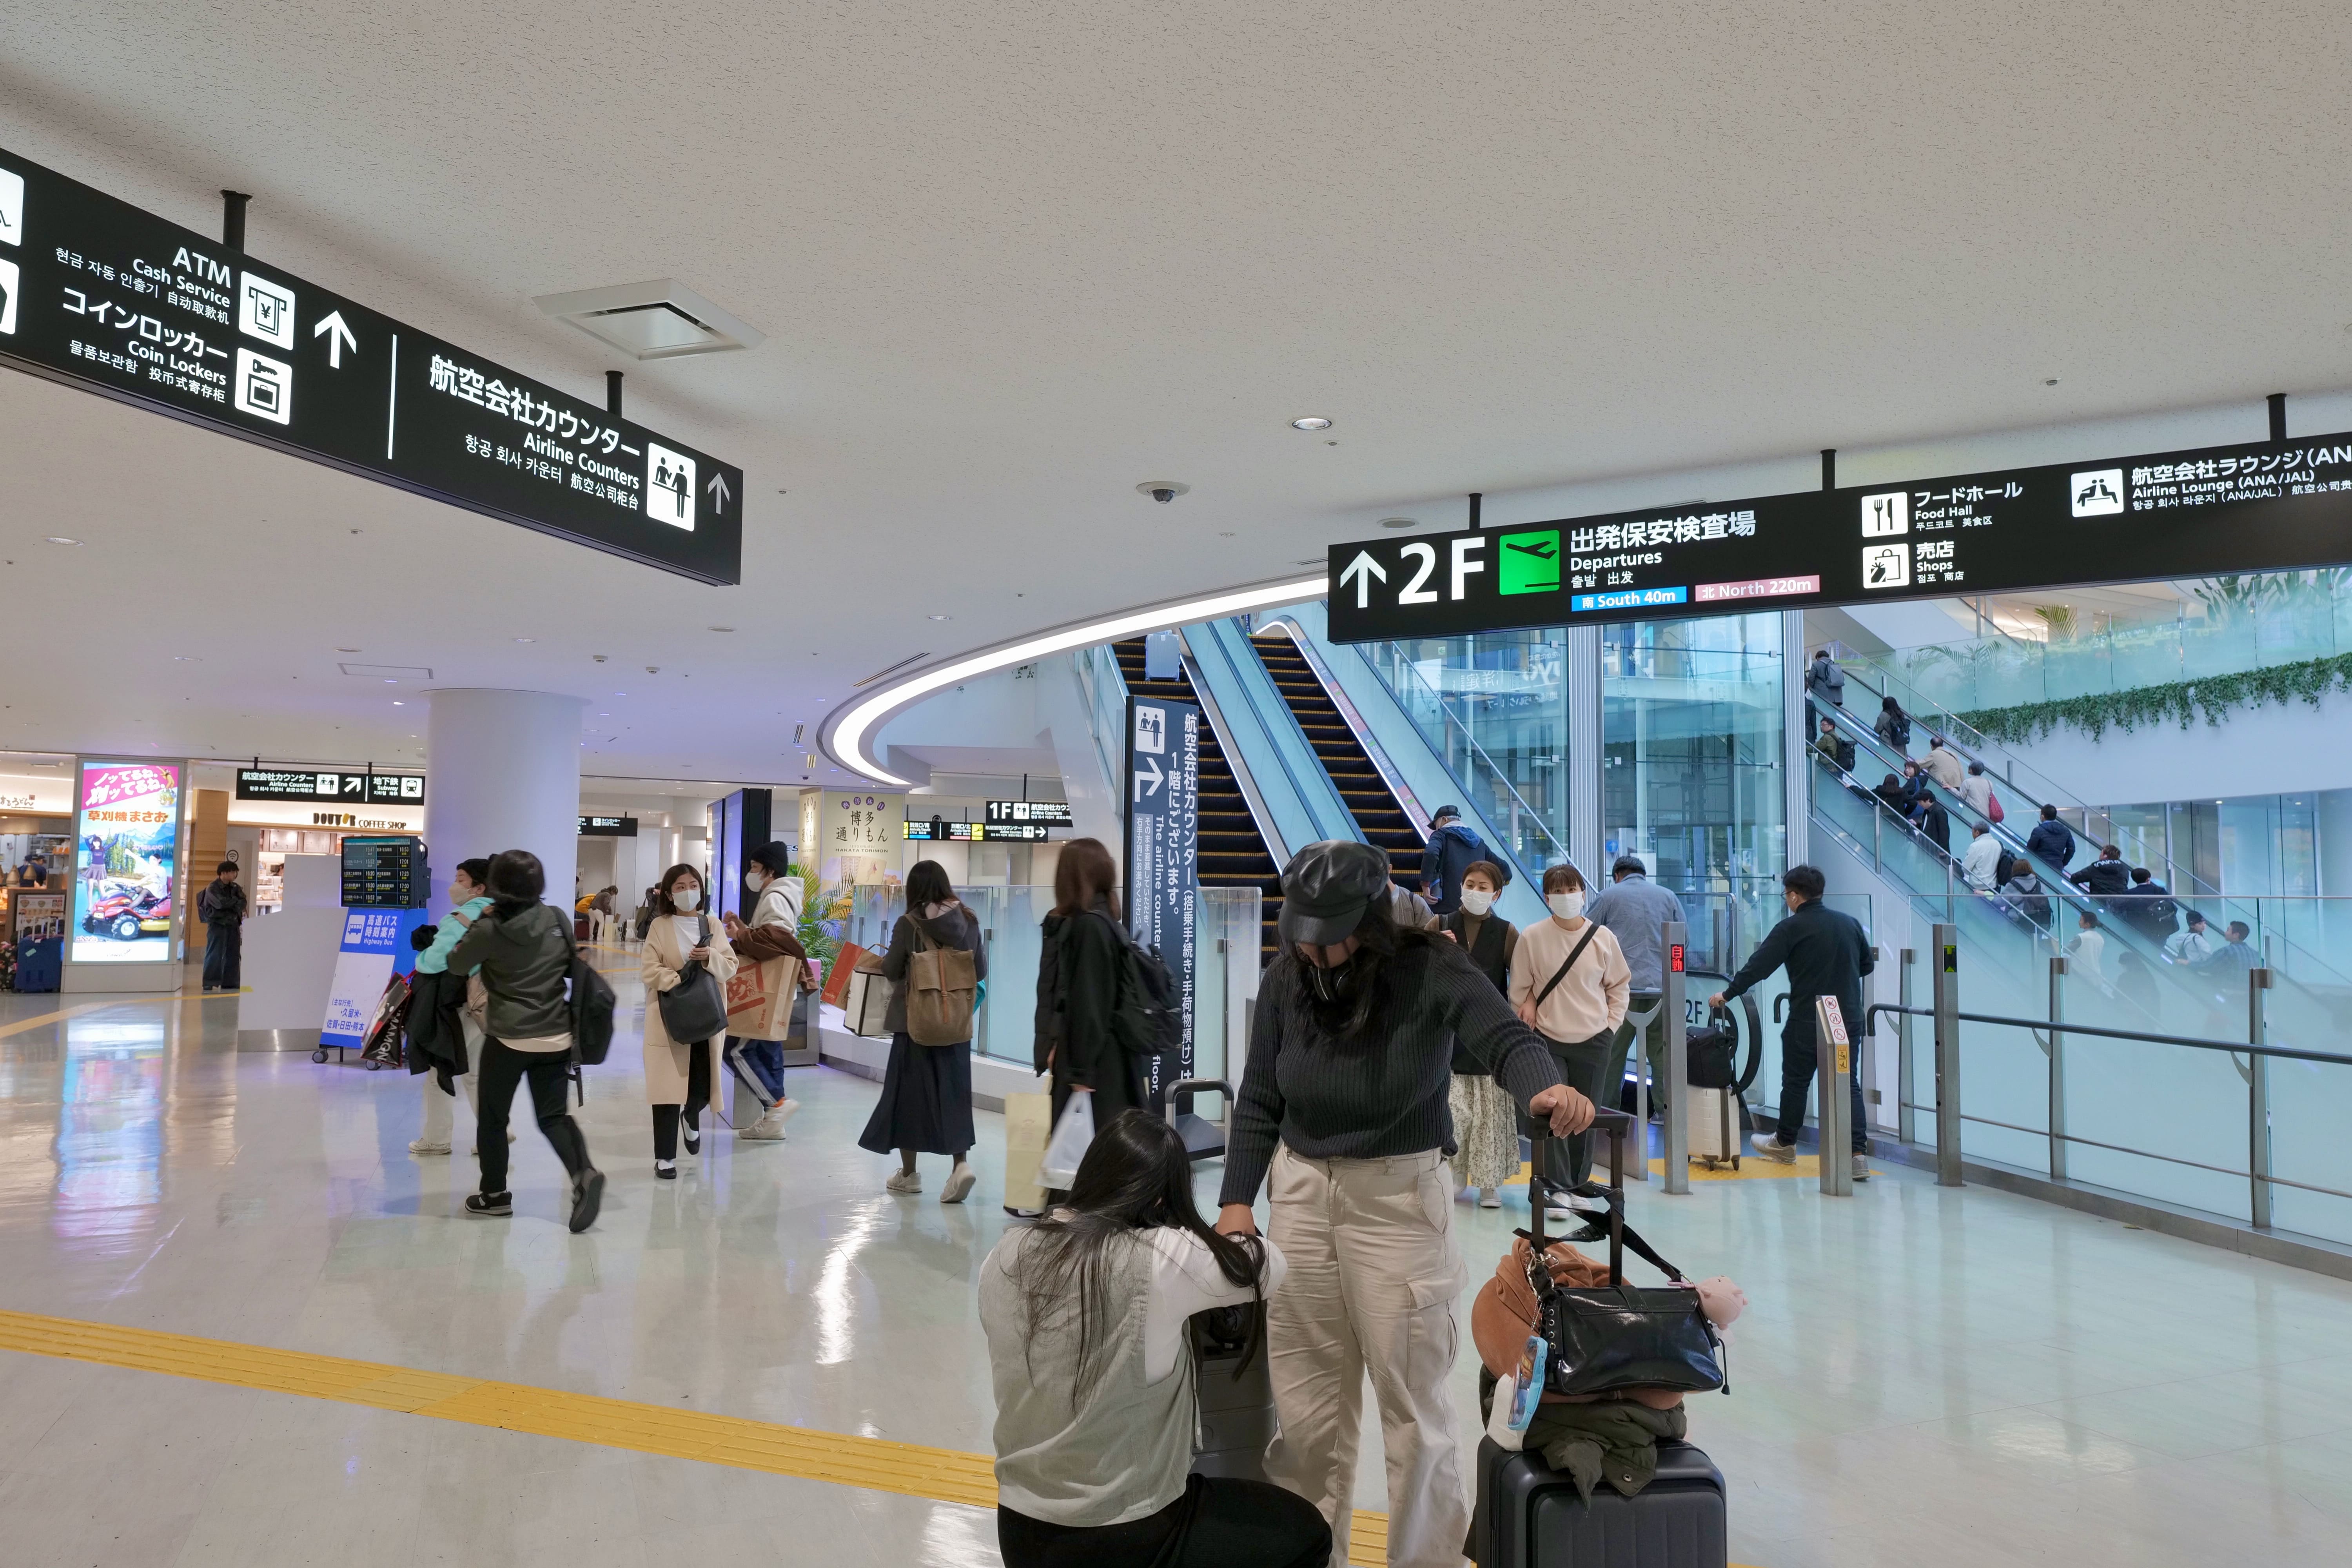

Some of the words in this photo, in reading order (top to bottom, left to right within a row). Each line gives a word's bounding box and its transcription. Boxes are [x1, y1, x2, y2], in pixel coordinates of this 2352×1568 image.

[56, 247, 83, 269] 현금
[88, 259, 116, 281] 자동
[120, 272, 159, 298] 인출기
[172, 247, 231, 288] ATM
[133, 258, 171, 284] Cash
[177, 276, 230, 308] Service
[167, 290, 229, 325] 自动取款机
[63, 287, 228, 359] コインロッカー
[69, 339, 138, 374] 물품보관함
[128, 341, 164, 364] Coin
[170, 355, 227, 385] Lockers
[149, 367, 225, 403] 投币式寄存柜
[430, 354, 640, 457] 航空会社カウンター
[465, 434, 492, 458] 항공
[496, 445, 522, 470] 회사
[526, 457, 562, 484] 카운터
[524, 432, 573, 465] Airline
[578, 452, 639, 490] Counters
[571, 473, 639, 510] 航空公司柜台
[1915, 482, 2023, 507] フードホール
[2132, 485, 2177, 498] Airline
[2182, 479, 2234, 495] Lounge
[2132, 500, 2154, 511] 항공
[2158, 497, 2179, 508] 회사
[2183, 493, 2216, 505] 라운지
[1915, 508, 1945, 520] Food
[1949, 505, 1972, 517] Hall
[1962, 515, 1993, 527] 美食区
[1571, 510, 1756, 553] 出発保安検査場
[1916, 520, 1954, 532] 푸드코트
[1916, 540, 1954, 560] 売店
[1399, 536, 1486, 605] 2F
[1571, 552, 1662, 572] Departures
[1916, 561, 1953, 572] Shops
[1571, 574, 1597, 589] 출발
[1608, 571, 1634, 586] 出发
[1917, 574, 1936, 584] 점포
[1944, 571, 1964, 582] 商店
[1702, 587, 1715, 599] 北
[1719, 582, 1764, 597] North
[1769, 579, 1812, 593] 220m
[1582, 597, 1593, 609] 南
[1598, 592, 1640, 608] South
[1644, 590, 1676, 603] 40m
[242, 771, 314, 782] 航空会社カウンター
[373, 777, 399, 786] 地下鉄
[87, 810, 169, 823] 草刈機まさお
[851, 810, 874, 826] 博多
[989, 802, 1011, 819] 1F
[313, 813, 356, 826] DOUTOR
[358, 819, 386, 828] COFFEE
[387, 822, 407, 830] SHOP
[1156, 815, 1164, 841] The
[836, 827, 889, 842] 通りもん
[1155, 846, 1164, 889] airline
[367, 914, 397, 926] 高速バス
[364, 938, 383, 946] Highway
[365, 926, 396, 938] 時刻案内
[1671, 945, 1683, 971] 自動
[1152, 1055, 1161, 1093] floor.
